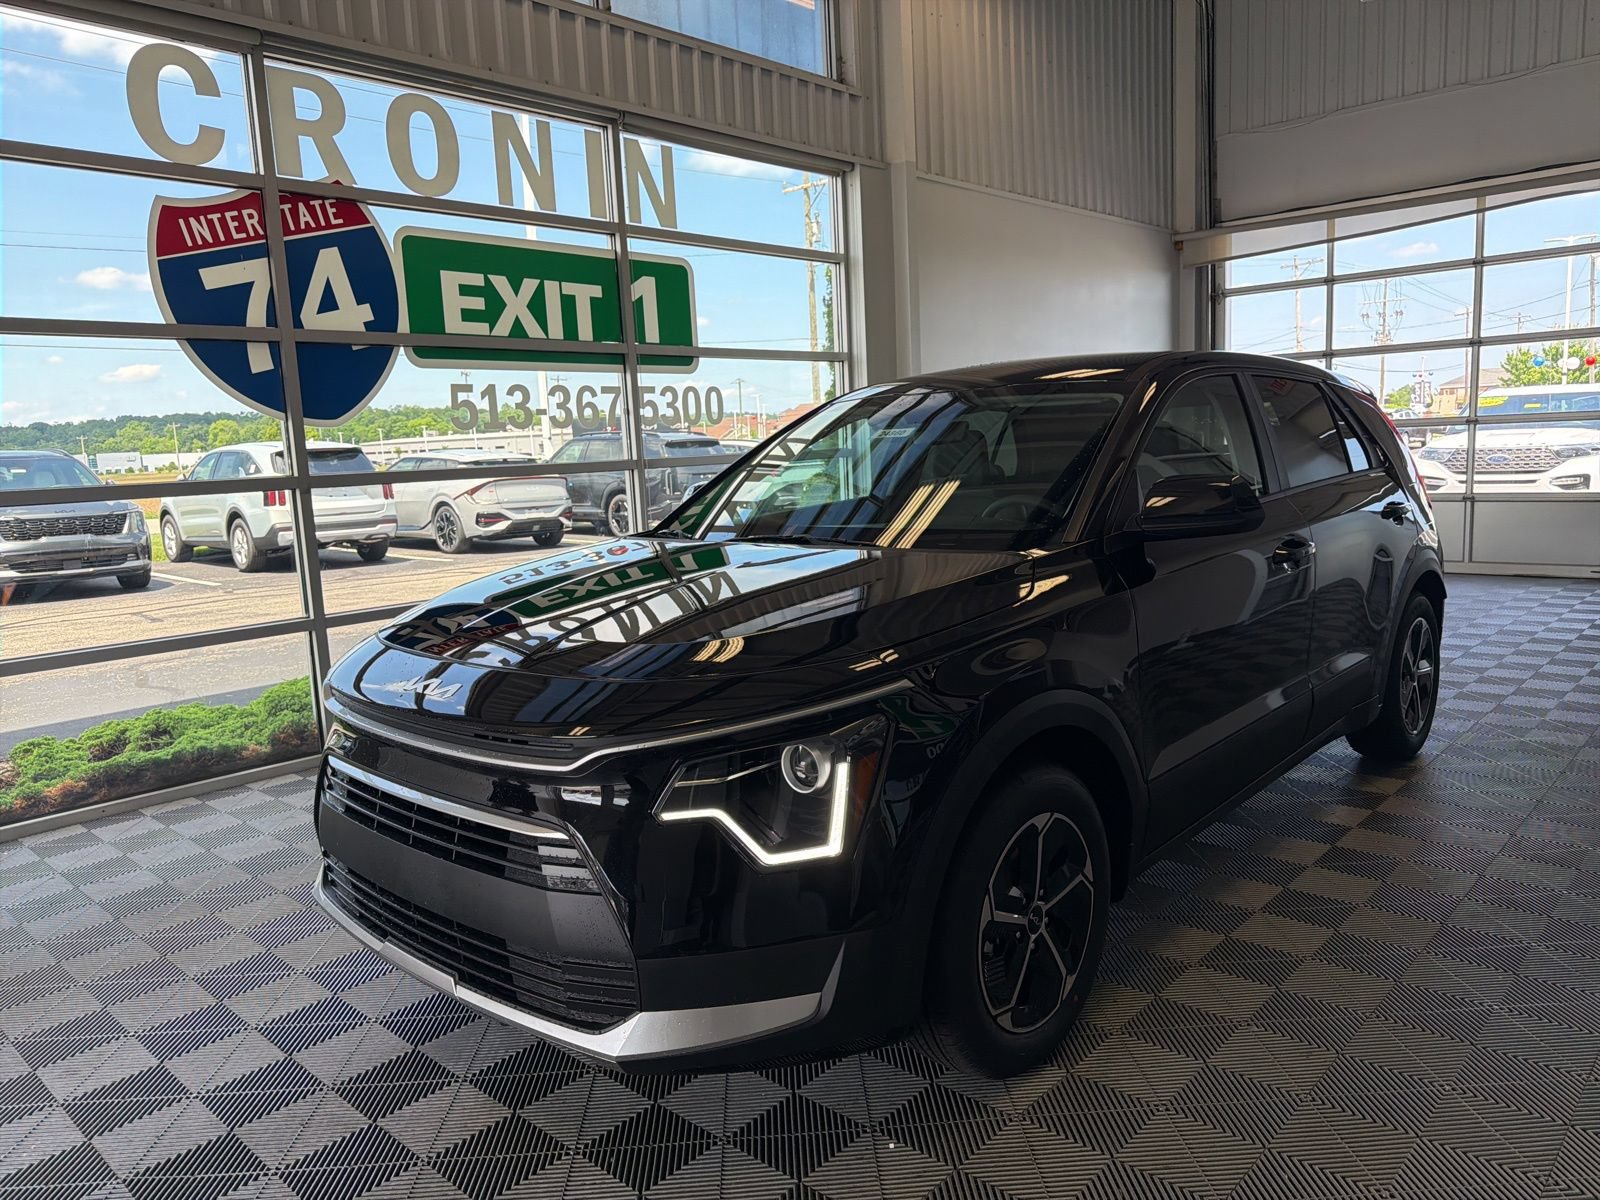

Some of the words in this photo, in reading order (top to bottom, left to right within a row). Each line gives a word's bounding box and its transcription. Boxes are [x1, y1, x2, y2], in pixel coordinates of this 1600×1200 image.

[126, 43, 678, 229] CRONIN
[178, 199, 344, 247] INTERTATE
[198, 246, 374, 374] 74
[439, 269, 603, 343] EXIT
[630, 275, 663, 345] 1
[450, 383, 724, 431] 513-3675300
